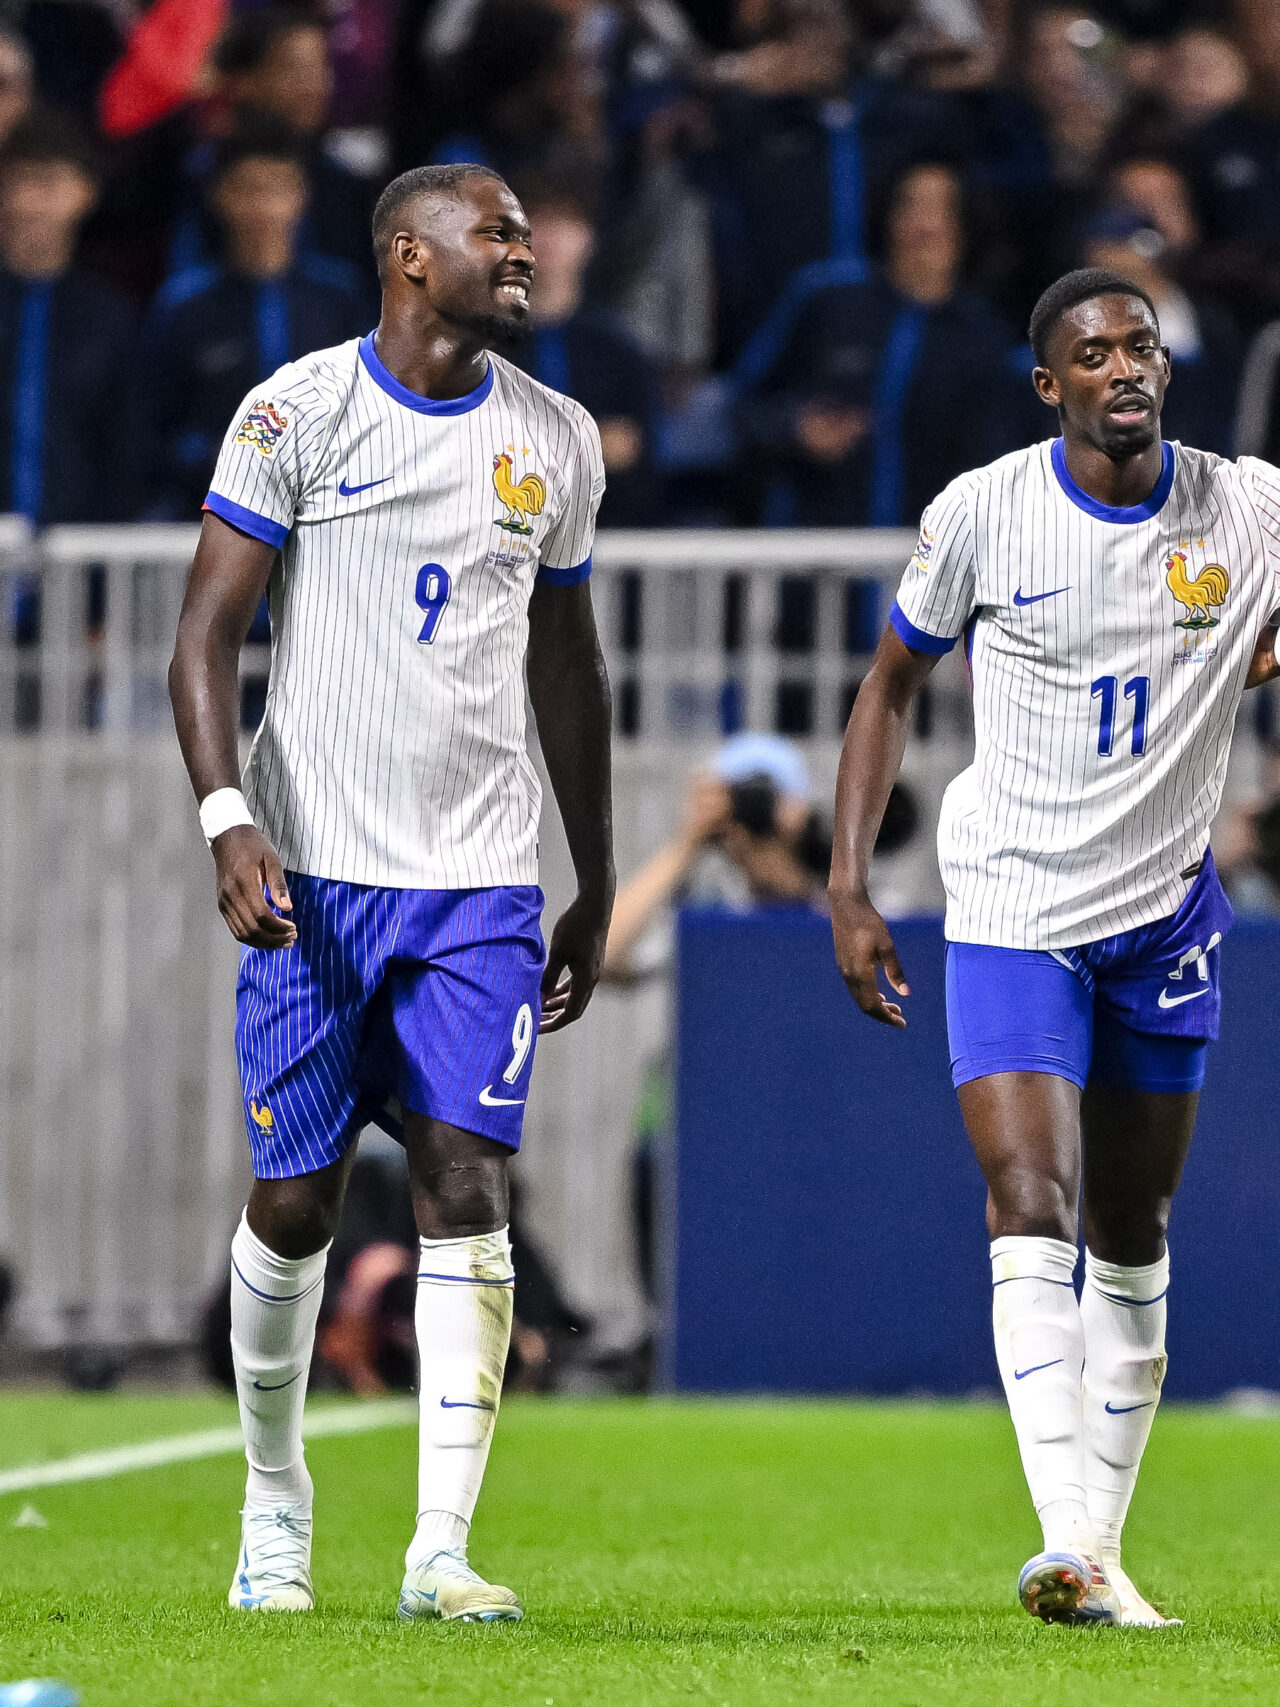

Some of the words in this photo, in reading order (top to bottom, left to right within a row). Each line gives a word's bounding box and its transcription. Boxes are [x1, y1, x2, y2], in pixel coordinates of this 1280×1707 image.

[415, 563, 452, 645] 9
[1091, 676, 1150, 757] 11
[503, 1003, 533, 1085] 9
